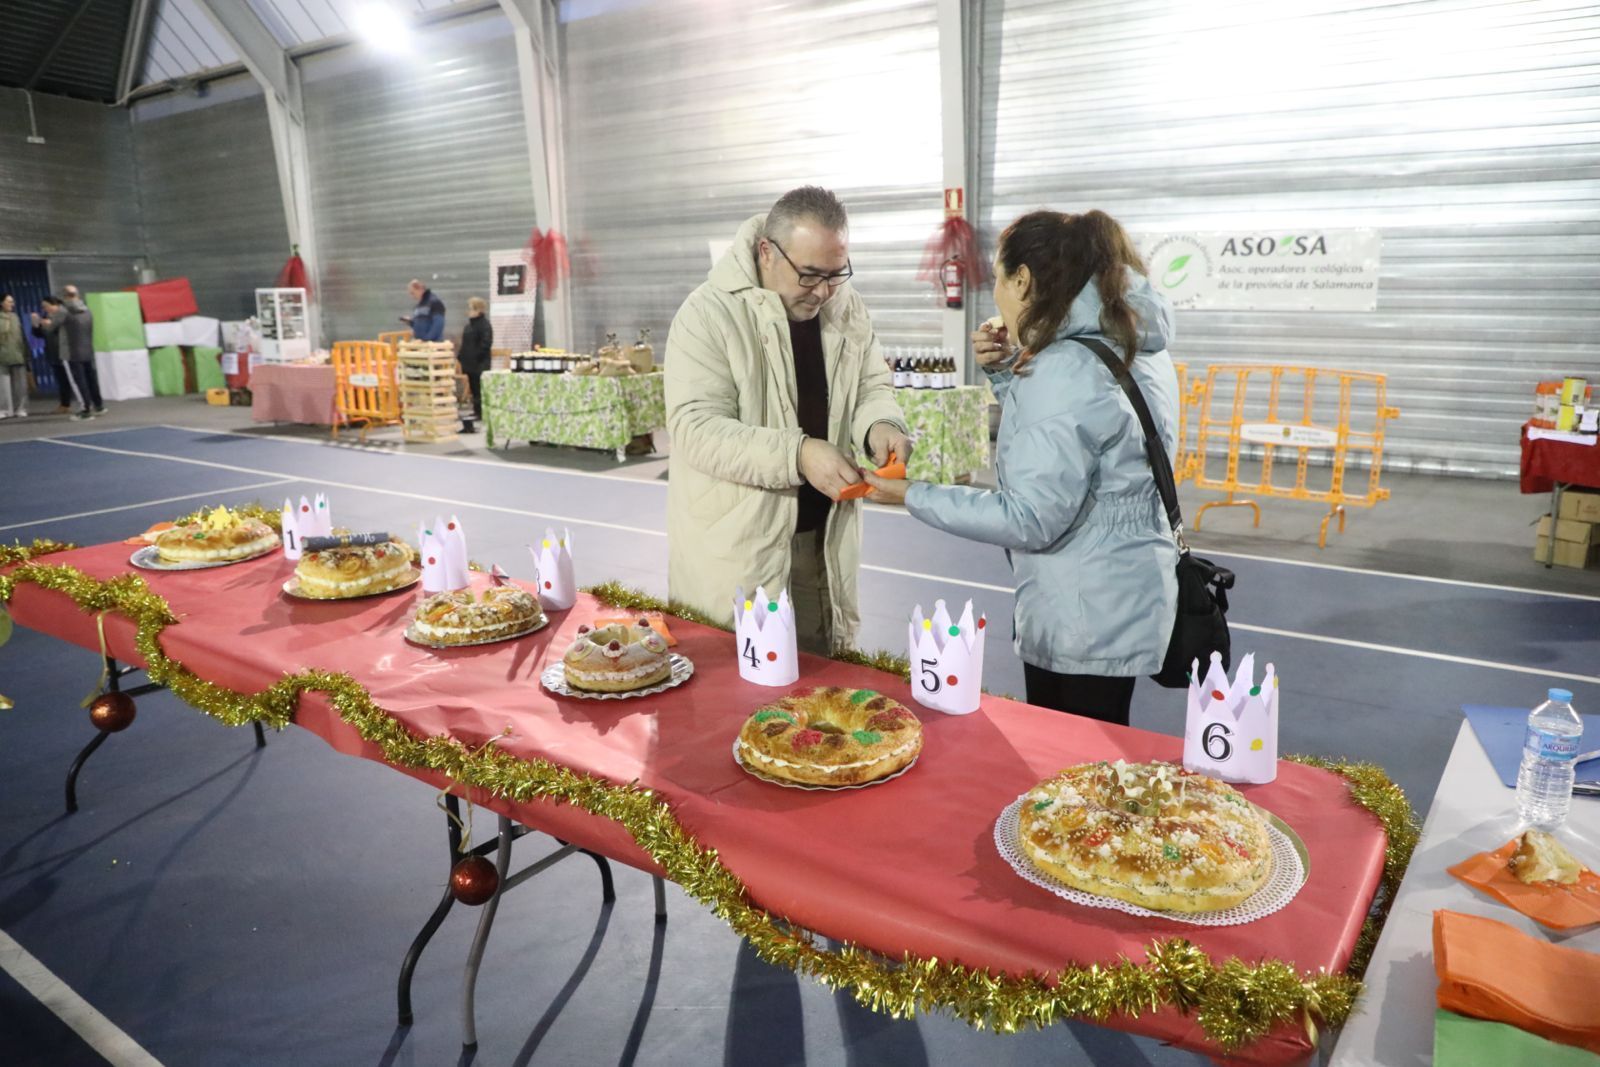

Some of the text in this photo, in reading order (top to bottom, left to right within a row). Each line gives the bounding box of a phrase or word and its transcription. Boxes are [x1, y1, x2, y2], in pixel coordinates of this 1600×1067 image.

[1247, 263, 1306, 275] operadores
[1218, 278, 1374, 290] de la provincia de Salamanca
[286, 530, 297, 550] 1
[742, 637, 761, 669] 4
[921, 658, 942, 694] 5
[1202, 722, 1233, 762] 6
